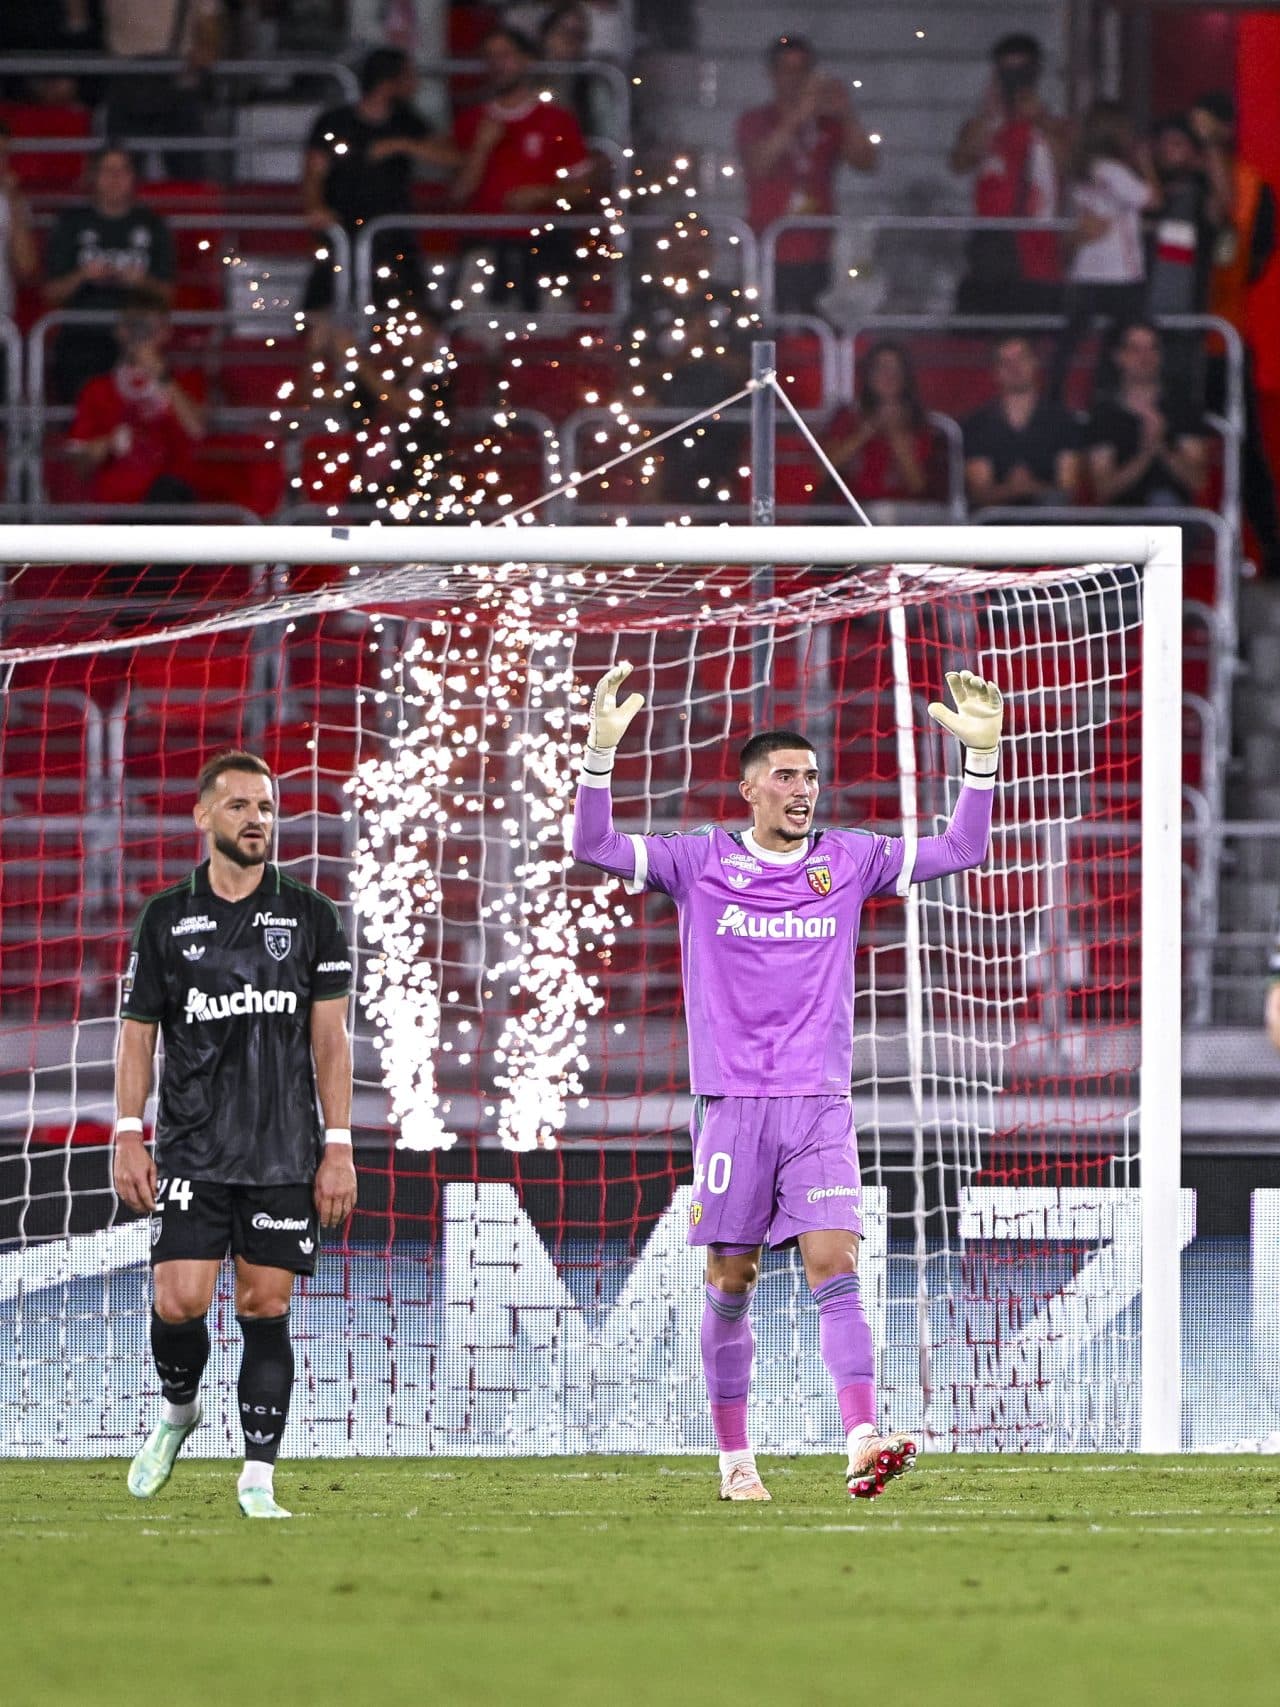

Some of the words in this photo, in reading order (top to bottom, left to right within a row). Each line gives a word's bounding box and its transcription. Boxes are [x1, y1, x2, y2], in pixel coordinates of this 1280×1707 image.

[252, 911, 298, 928] Nexans
[716, 904, 836, 938] Auchan
[184, 983, 298, 1024] Auchan
